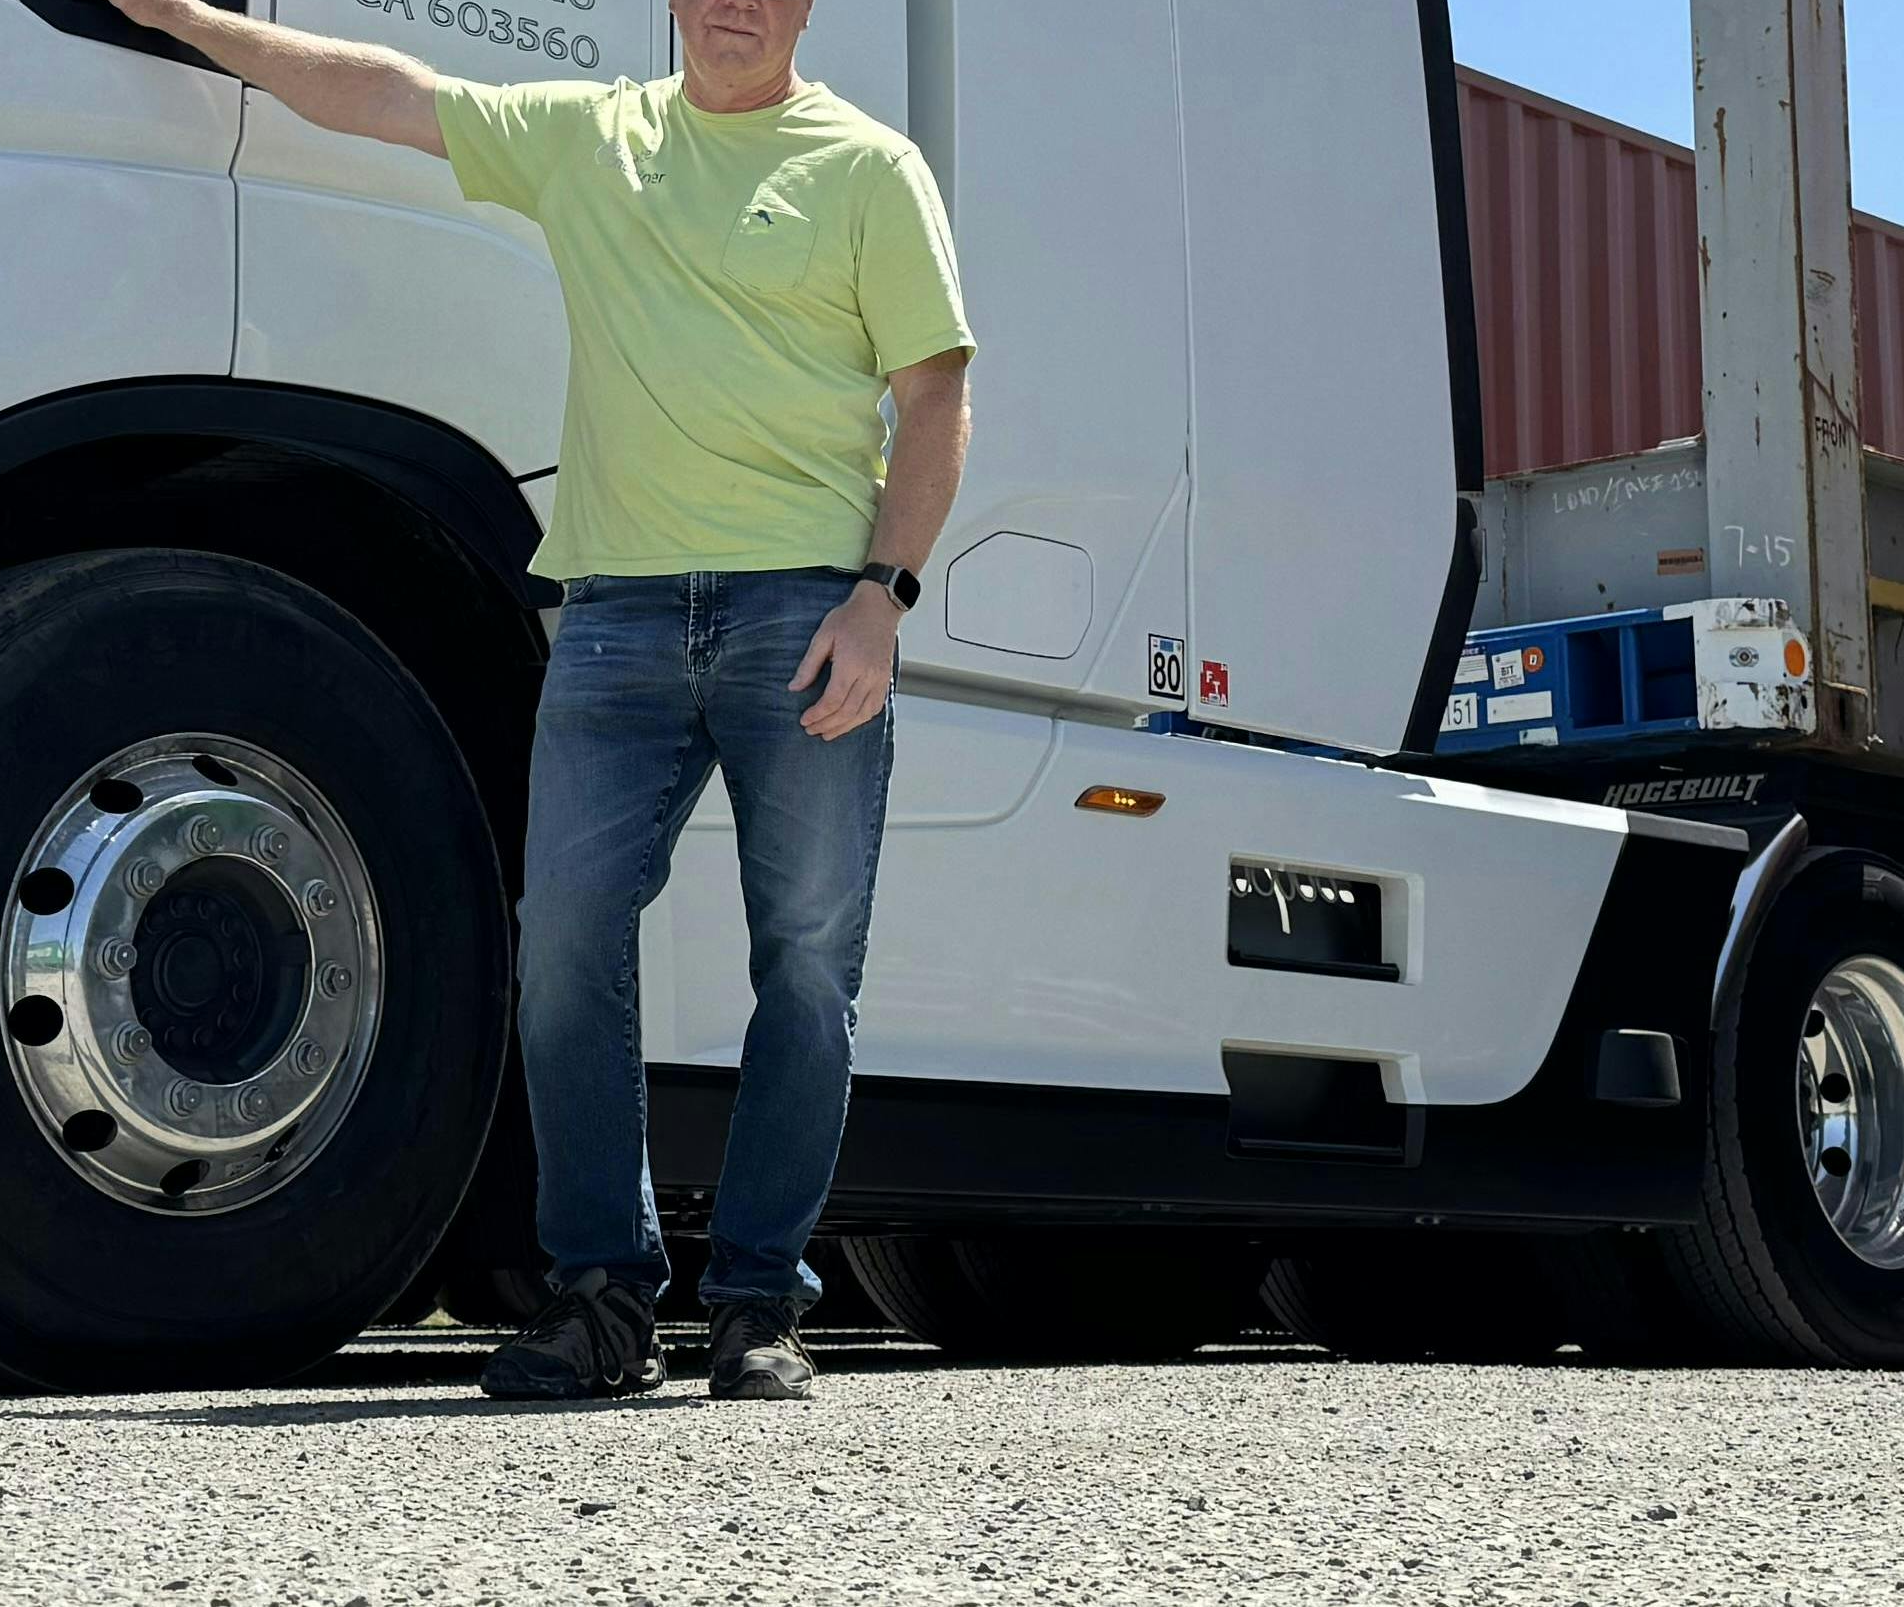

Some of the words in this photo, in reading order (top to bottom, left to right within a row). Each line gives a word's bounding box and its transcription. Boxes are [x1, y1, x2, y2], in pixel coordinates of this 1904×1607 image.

[1724, 525, 1795, 569] 7-15
[1153, 652, 1181, 692] 80
[1602, 773, 1765, 807] HOGEBUILT
